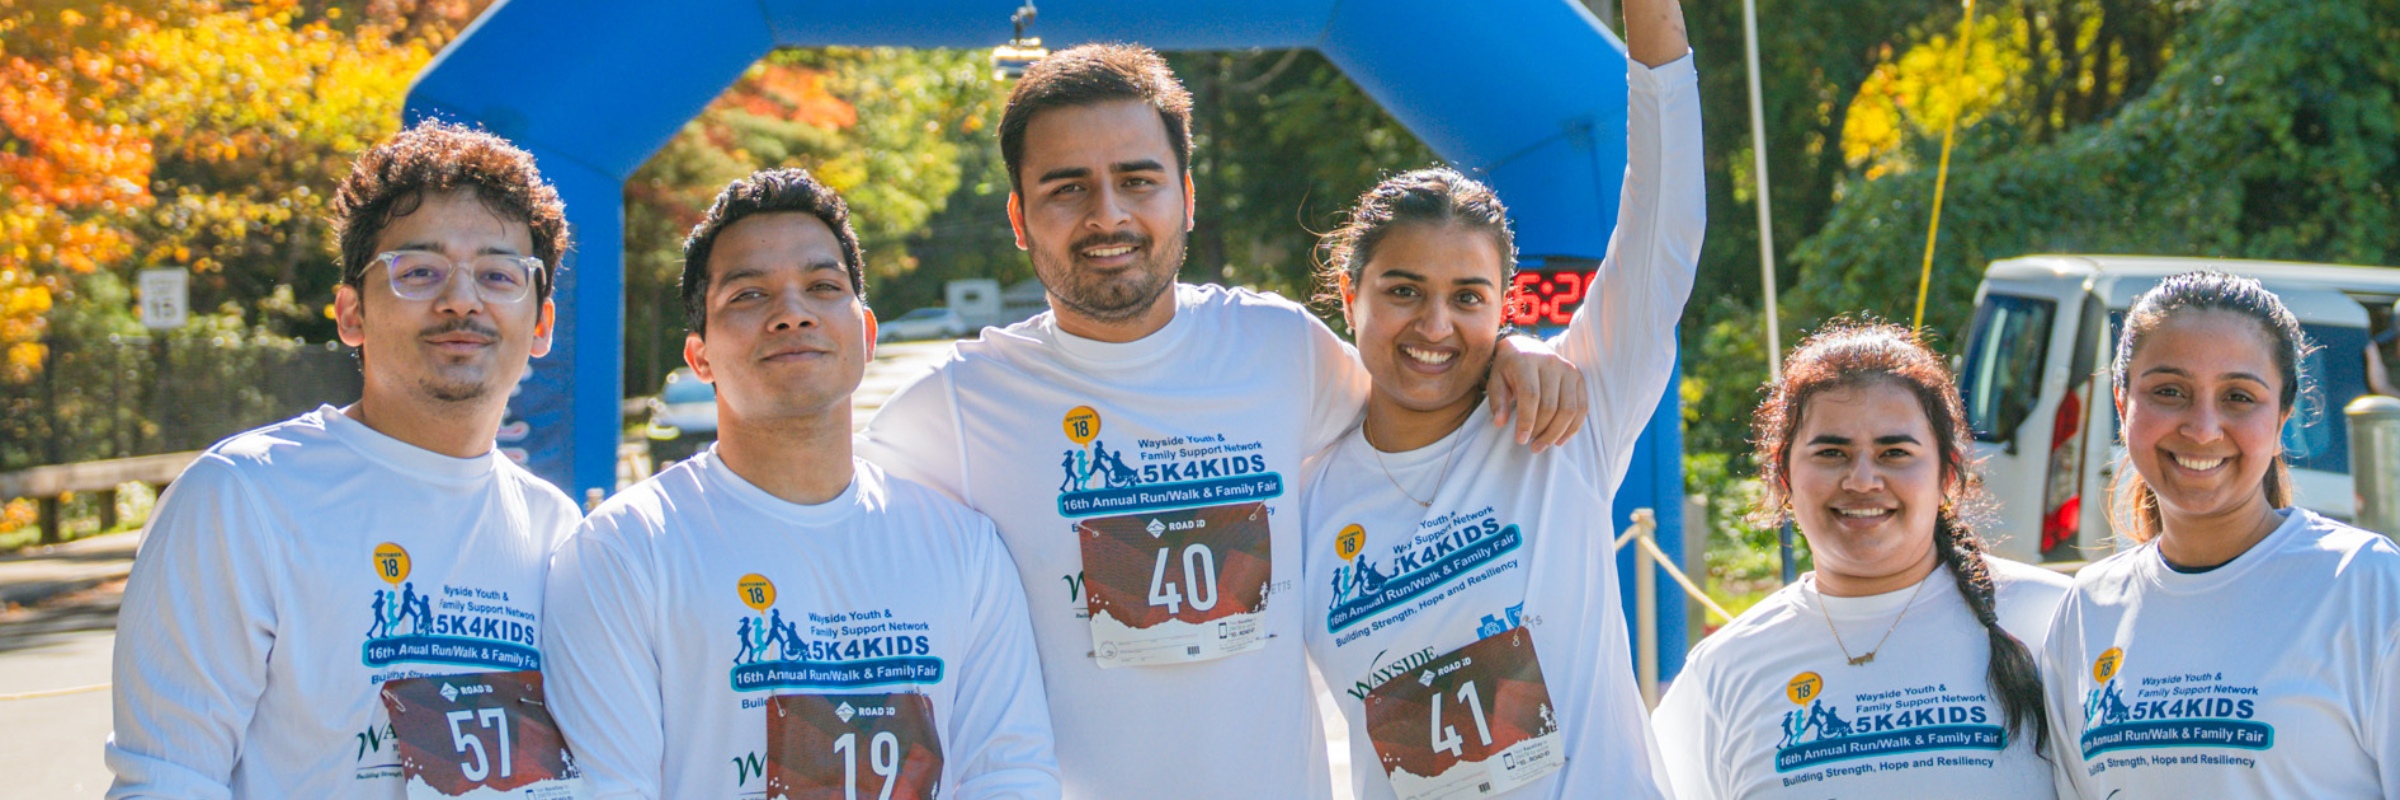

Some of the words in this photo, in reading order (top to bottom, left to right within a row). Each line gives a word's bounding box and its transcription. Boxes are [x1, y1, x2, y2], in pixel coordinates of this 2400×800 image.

[1072, 421, 1089, 438] 18
[1138, 436, 1184, 450] Wayside
[1186, 434, 1215, 443] Youth
[1217, 433, 1225, 442] &
[1141, 450, 1176, 462] Family
[1180, 446, 1223, 459] Support
[1224, 441, 1262, 452] Network
[1144, 454, 1266, 483] 5K4KIDS
[1063, 497, 1090, 511] 16th
[1092, 492, 1137, 508] Annual
[1140, 487, 1200, 503] Run/Walk
[1203, 486, 1213, 498] &
[1216, 483, 1255, 497] Family
[1257, 480, 1278, 493] Fair
[1169, 521, 1194, 531] ROAD
[1415, 524, 1452, 545] Support
[1453, 506, 1495, 526] Network
[1420, 514, 1449, 529] Youth
[1343, 537, 1355, 554] 18
[382, 558, 399, 577] 18
[1148, 543, 1218, 615] 40
[1331, 612, 1348, 627] 16th
[1349, 594, 1385, 618] Annual
[1386, 573, 1441, 601] Run/Walk
[1442, 564, 1452, 575] &
[1453, 546, 1492, 571] Family
[1493, 533, 1515, 550] Fair
[475, 587, 500, 600] Youth
[502, 591, 509, 601] &
[747, 587, 765, 604] 18
[1336, 627, 1371, 648] Building
[1371, 606, 1418, 632] Strength,
[1418, 594, 1445, 611] Hope
[1447, 583, 1466, 597] and
[1467, 559, 1519, 586] Resiliency
[439, 599, 465, 613] Family
[467, 601, 504, 615] Support
[505, 606, 535, 621] Network
[808, 609, 847, 624] Wayside
[849, 610, 881, 622] Youth
[884, 609, 893, 618] &
[436, 614, 535, 645] 5K4KIDS
[811, 626, 839, 639] Family
[841, 623, 886, 637] Support
[889, 621, 930, 632] Network
[369, 647, 395, 660] 16th
[398, 643, 429, 656] Anual
[431, 643, 478, 658] Run/Walk
[481, 647, 490, 660] &
[492, 649, 524, 667] Family
[813, 635, 930, 661] 5K4KIDS
[736, 670, 764, 684] 16th
[767, 669, 807, 682] Annual
[809, 669, 860, 681] Run/Walk
[864, 668, 874, 679] &
[877, 665, 917, 678] Family
[917, 665, 938, 676] Fair
[1347, 645, 1439, 701] WAYSIDE
[1437, 661, 1461, 676] ROAD
[2100, 660, 2113, 678] 18
[2142, 674, 2182, 686] Wayside
[2185, 673, 2212, 683] Youth
[2214, 672, 2222, 681] &
[460, 685, 484, 695] ROAD
[1796, 683, 1811, 699] 18
[1855, 688, 1901, 702] Wayside
[1904, 684, 1935, 695] Youth
[1938, 684, 1947, 692] &
[2137, 687, 2170, 698] Family
[2172, 685, 2212, 696] Support
[2214, 685, 2258, 696] Network
[858, 707, 884, 717] ROAD
[1856, 702, 1892, 714] Family
[1895, 697, 1940, 710] Support
[1942, 693, 1986, 703] Network
[2132, 697, 2255, 720] 5K4KIDS
[1430, 680, 1493, 757] 41
[1856, 706, 1987, 733] 5K4KIDS
[446, 707, 512, 781] 57
[2093, 731, 2122, 748] Annual
[2125, 728, 2178, 741] Run/Walk
[2181, 727, 2190, 739] &
[2194, 728, 2234, 742] Family
[2237, 729, 2264, 743] Fair
[1780, 754, 1802, 767] 16th
[1804, 744, 1847, 760] Annual
[1850, 736, 1911, 753] Run/Walk
[1915, 735, 1925, 746] &
[1928, 732, 1971, 745] Family
[1974, 731, 1999, 744] Fair
[834, 731, 900, 800] 19
[1783, 770, 1824, 788] Building
[1826, 764, 1877, 779] Strength,
[1879, 760, 1909, 773] Hope
[1912, 755, 1934, 768] and
[1937, 756, 1994, 769] Resiliency
[2107, 756, 2150, 769] Strength,
[2152, 754, 2178, 766] Hope
[2180, 754, 2198, 764] and
[2200, 754, 2256, 768] Resiliency
